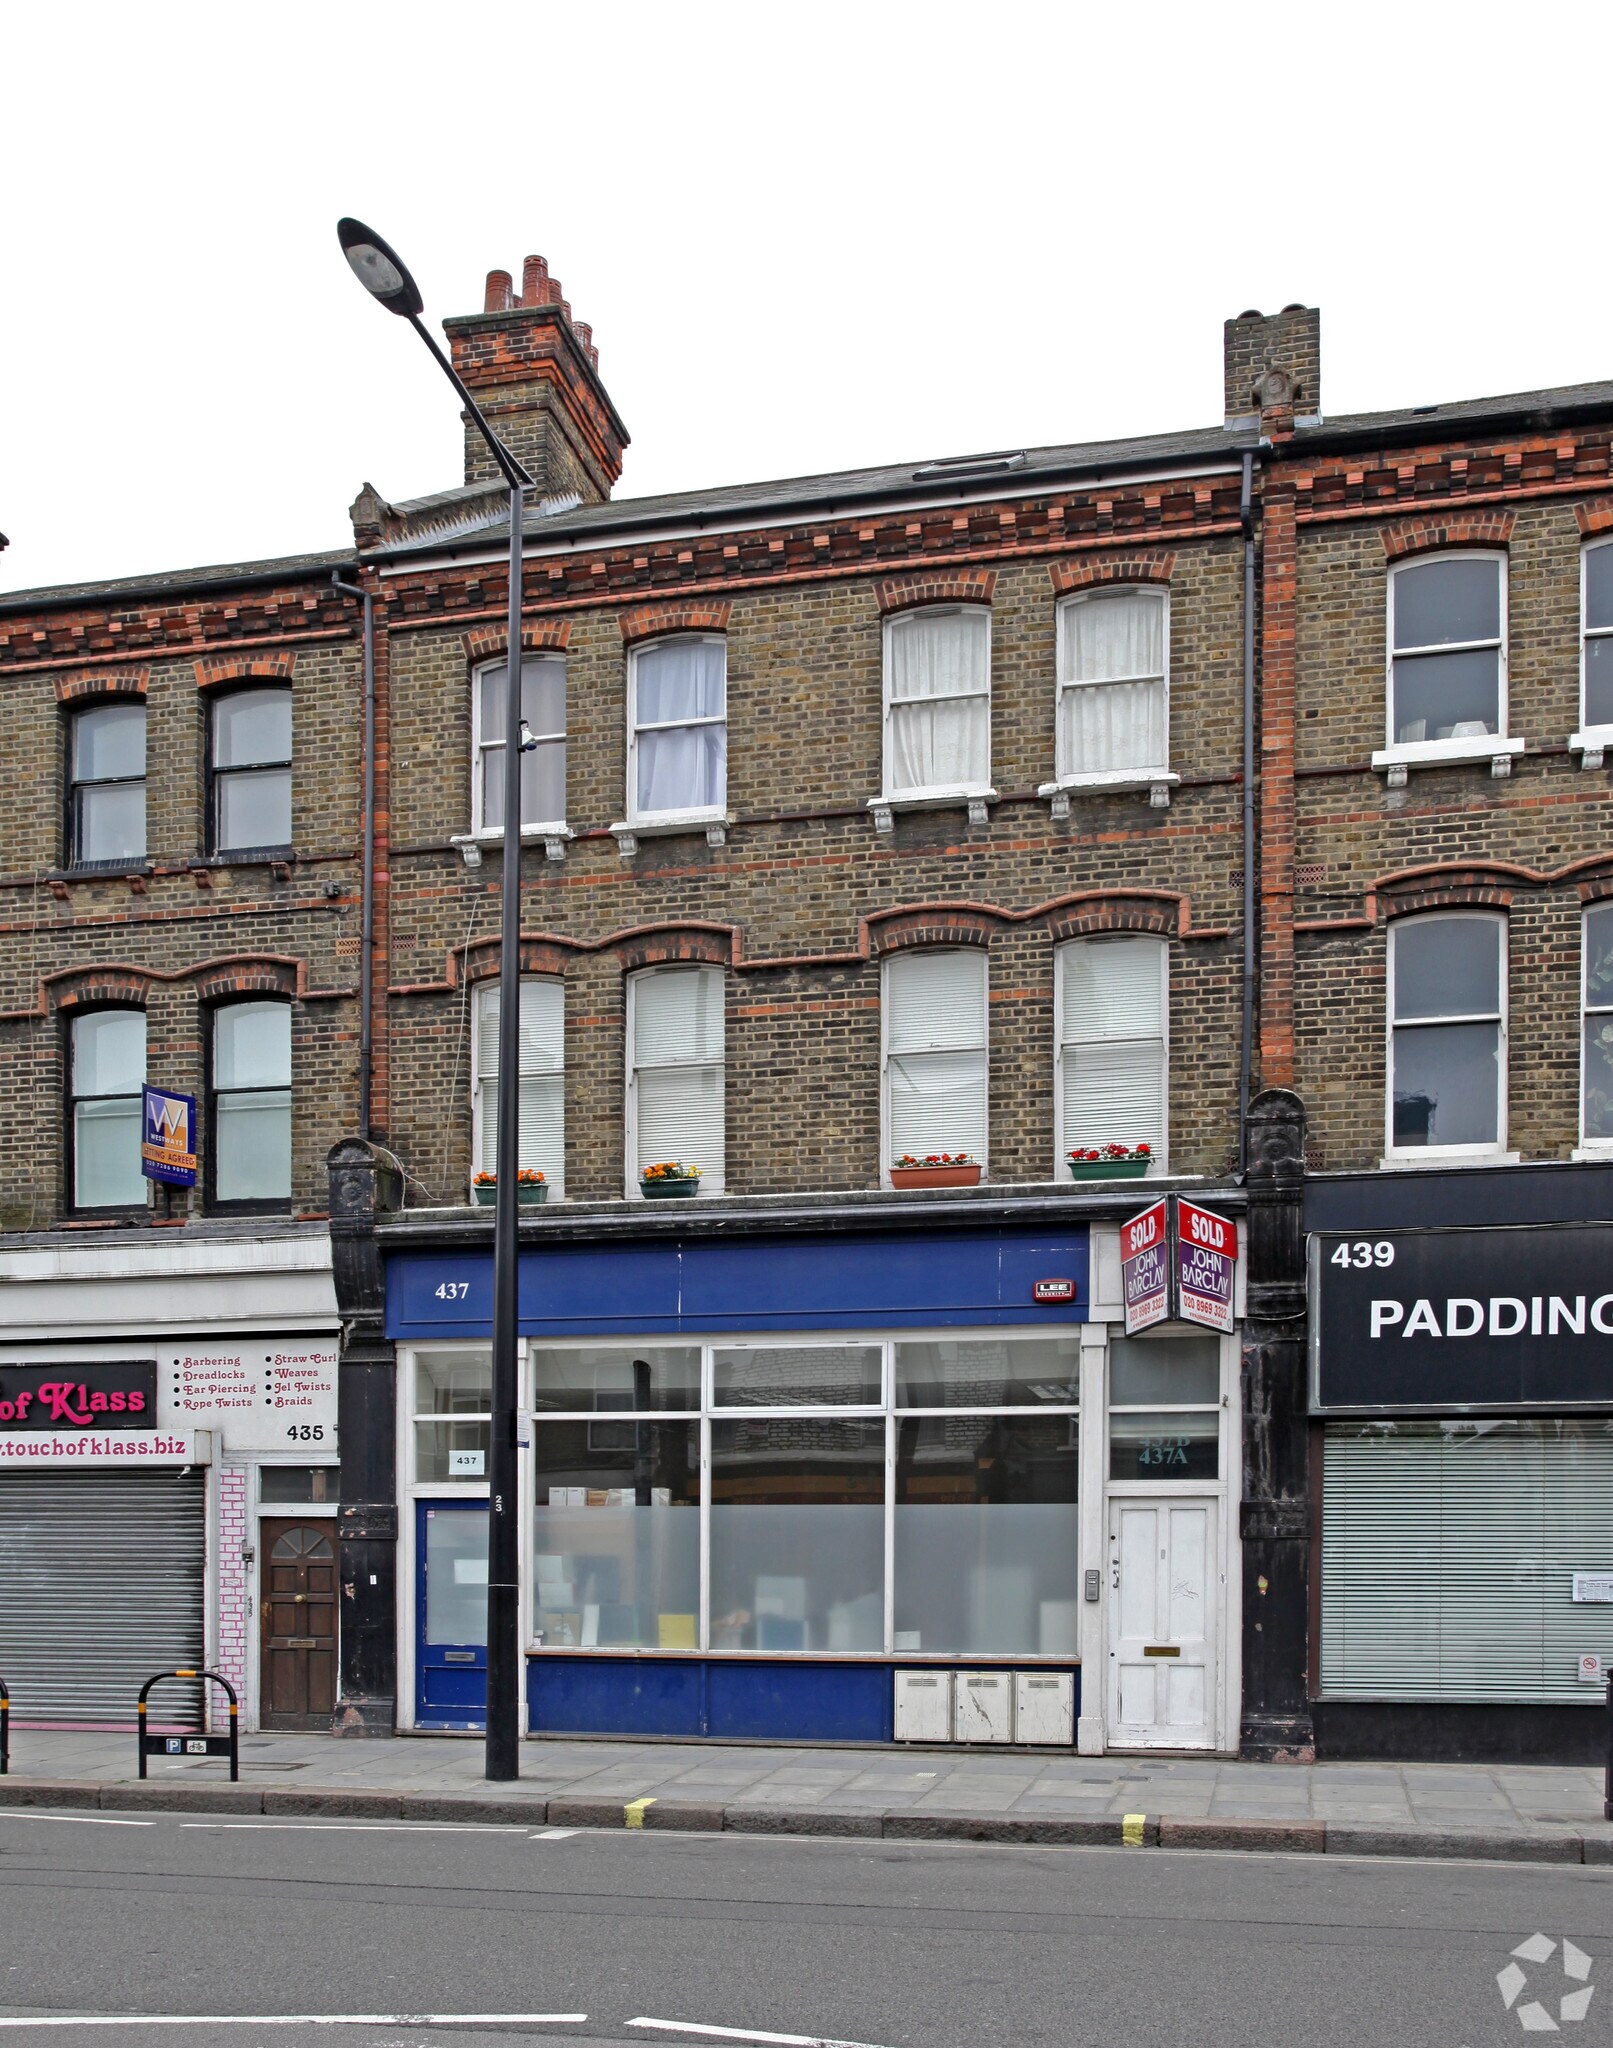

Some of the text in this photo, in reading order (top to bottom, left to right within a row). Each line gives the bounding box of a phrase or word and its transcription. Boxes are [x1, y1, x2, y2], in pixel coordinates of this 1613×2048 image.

[150, 1133, 183, 1146] WESTWAYS
[168, 1153, 194, 1165] AGREED
[1130, 1215, 1155, 1252] SOLD
[1191, 1213, 1224, 1248] SOLD
[1134, 1248, 1158, 1276] JOHN
[1190, 1247, 1222, 1273] JOHN
[1330, 1241, 1395, 1268] 439
[1128, 1263, 1165, 1298] BARCLAY
[1182, 1263, 1229, 1295] BARCLAY
[435, 1282, 470, 1299] 437
[1040, 1283, 1068, 1291] LEE
[1183, 1295, 1227, 1320] 020 8969 3322
[183, 1356, 241, 1368] Barbering
[274, 1353, 337, 1366] Straw Curl
[183, 1370, 245, 1381] Dreadlocks
[274, 1368, 319, 1379] Weaves
[183, 1384, 257, 1395] Ear Piercing
[294, 1382, 331, 1393] Twists
[0, 1382, 146, 1425] of Klass
[183, 1398, 253, 1410] Rope Twists
[274, 1396, 313, 1408] Braids
[287, 1424, 324, 1441] 435
[0, 1436, 186, 1457] .touchofklass.biz
[457, 1457, 477, 1465] 437
[1138, 1447, 1189, 1464] 437A
[170, 1740, 179, 1751] P
